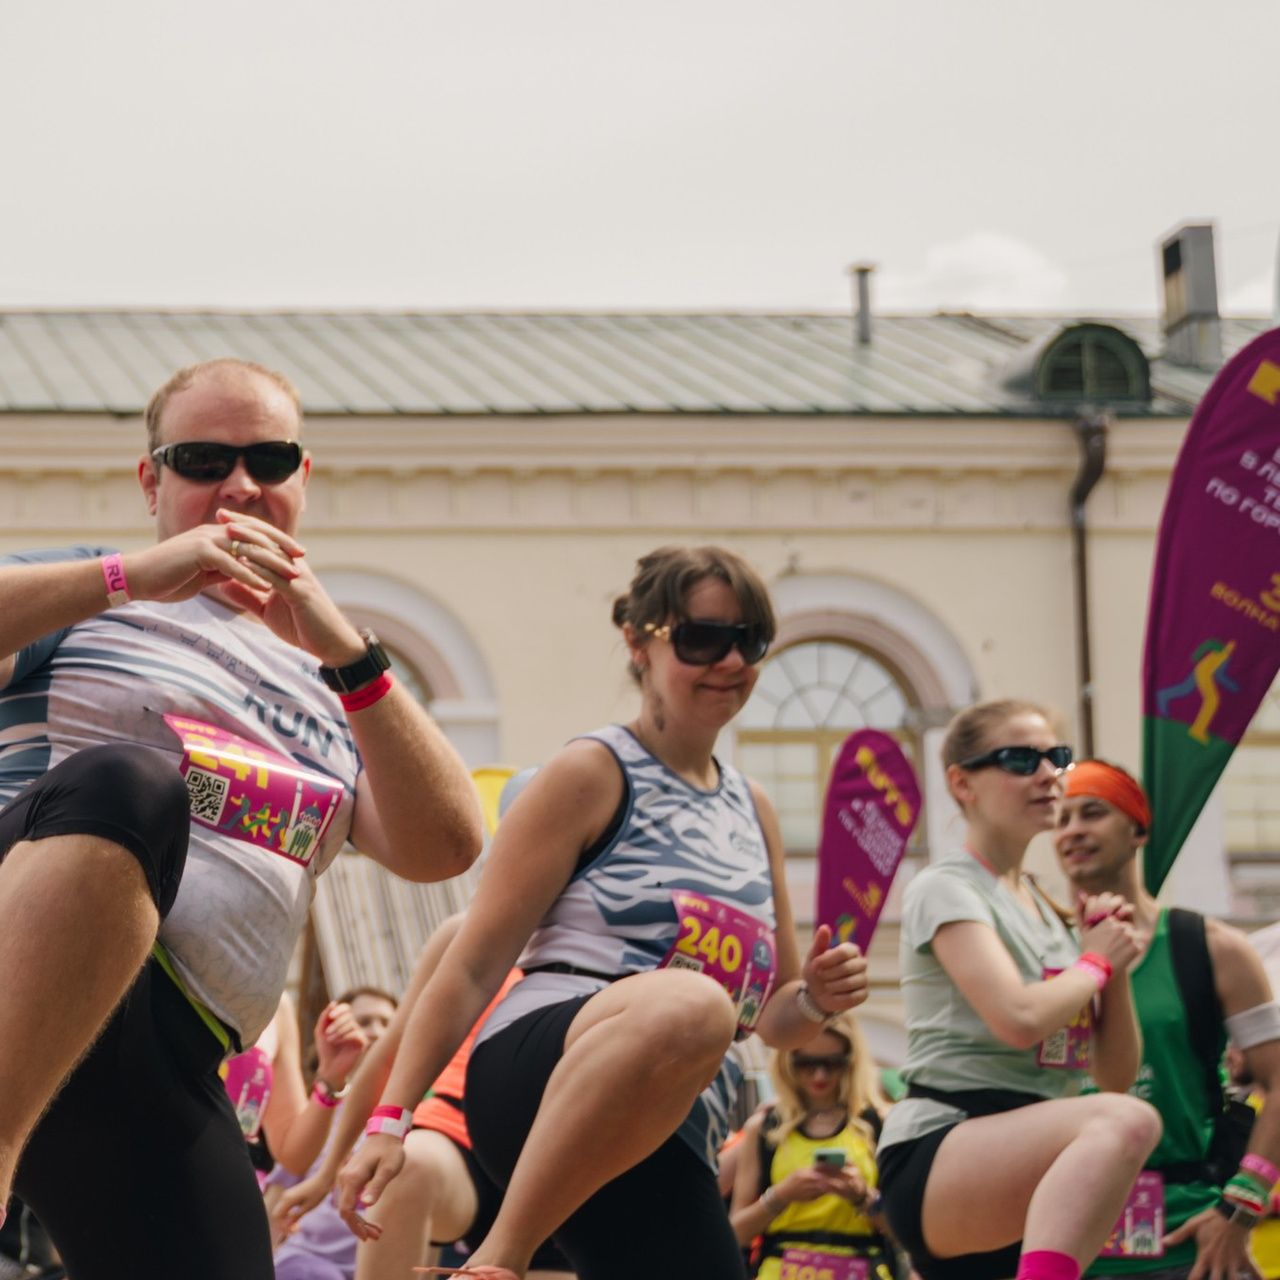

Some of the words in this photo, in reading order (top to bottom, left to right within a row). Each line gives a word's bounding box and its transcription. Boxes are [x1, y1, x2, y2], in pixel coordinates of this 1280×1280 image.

[1205, 477, 1241, 507] ПО
[1239, 498, 1280, 535] ГОР
[243, 690, 336, 760] RUN
[183, 732, 270, 789] 241
[675, 916, 743, 974] 240
